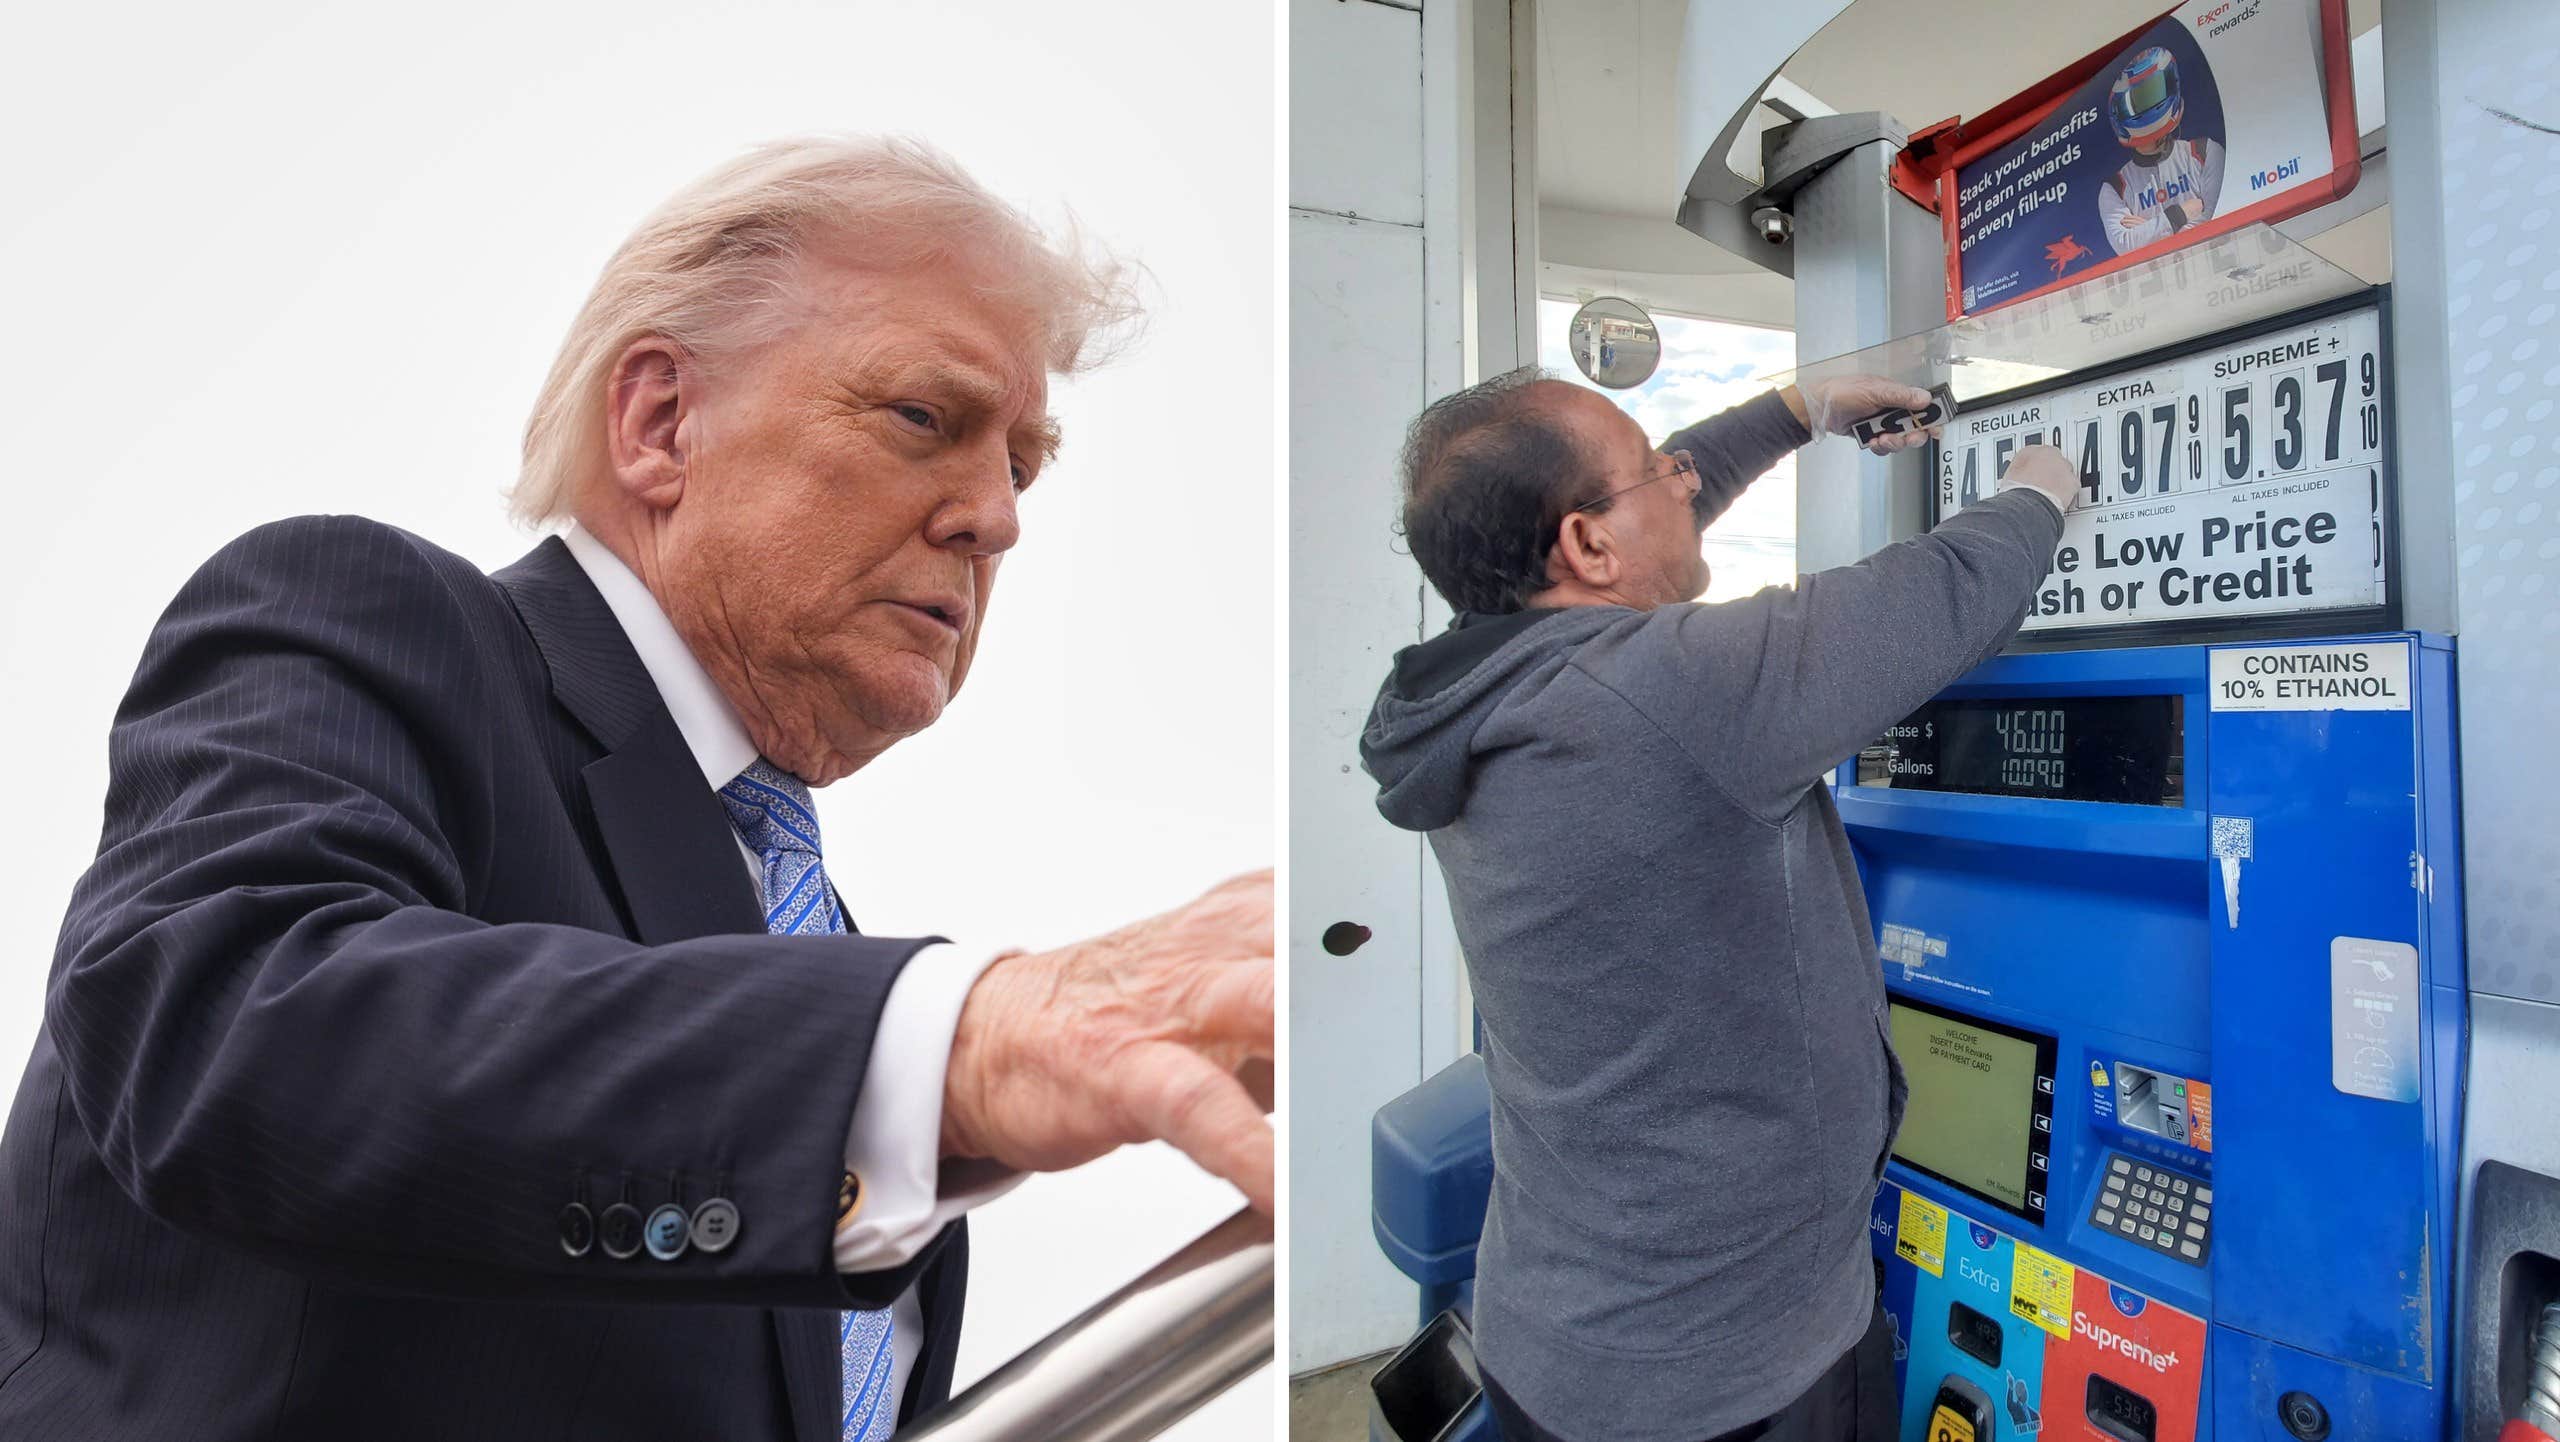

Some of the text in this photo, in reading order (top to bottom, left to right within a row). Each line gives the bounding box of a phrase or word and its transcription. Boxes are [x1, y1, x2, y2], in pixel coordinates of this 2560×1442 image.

[2197, 3, 2230, 26] Exxon
[1960, 107, 2098, 207] Stack your benefits
[1960, 144, 2081, 230] and earn rewards
[2250, 157, 2299, 190] Mobil
[2138, 173, 2190, 210] Mobil
[1961, 182, 2067, 252] on every fill-up
[2214, 337, 2320, 378] SUPREME
[2097, 380, 2155, 407] EXTRA
[1971, 407, 2041, 435] REGULAR
[2224, 359, 2347, 480] 5.37
[1943, 450, 1953, 504] CASH
[2232, 479, 2330, 503] ALL TAXES INCLUDED
[2096, 505, 2176, 524] ALL TAXES INCLUDED
[2095, 532, 2184, 569] Low
[2202, 510, 2337, 557] Price
[2027, 554, 2313, 616] sh or Credit
[2243, 653, 2369, 675] CONTAINS
[2221, 677, 2397, 699] 10% ETHANOL
[1925, 721, 1933, 740] $
[1996, 710, 2065, 754] 46.00
[1888, 758, 1934, 775] Gallons
[2002, 758, 2065, 788] 10.090
[1930, 1034, 1953, 1048] INSERT
[1965, 1047, 1992, 1061] Rewards
[1946, 1029, 1978, 1044] WELCOME
[1930, 1046, 1991, 1073] OR PAYMENT CARD
[1869, 1213, 1894, 1237] ular
[1899, 1238, 1917, 1255] NYC
[1959, 1256, 2000, 1293] Extra
[2014, 1295, 2037, 1315] NYC
